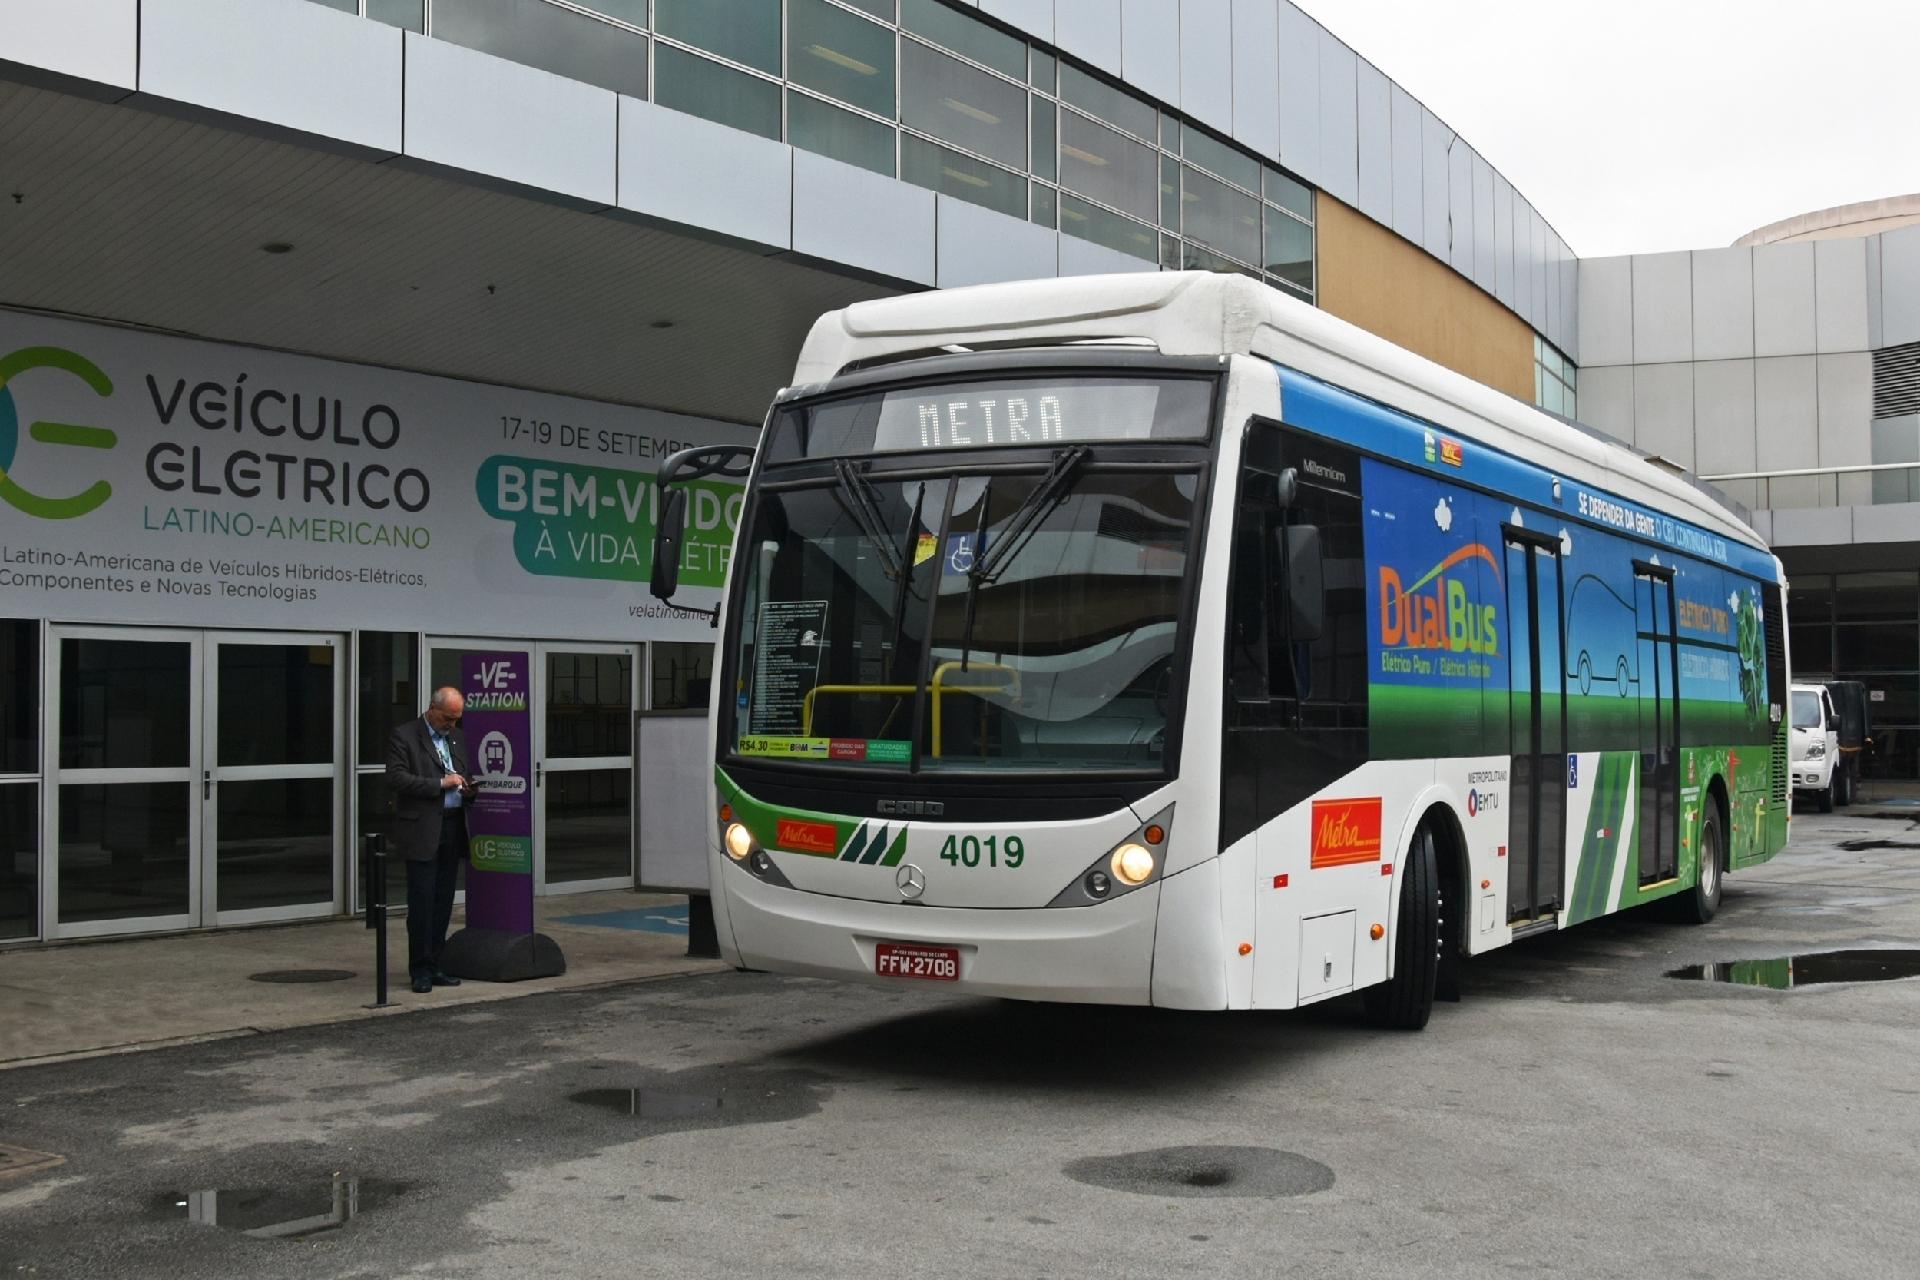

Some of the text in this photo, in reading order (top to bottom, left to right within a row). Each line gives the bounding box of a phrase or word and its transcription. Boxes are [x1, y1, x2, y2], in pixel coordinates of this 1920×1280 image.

[146, 373, 400, 450] VEÍCULO
[919, 396, 1063, 447] METRA
[500, 416, 700, 459] 17-19 DE SETEMB
[144, 505, 430, 549] LATINO-AMERICANO
[1577, 491, 1588, 515] SE
[1588, 496, 1624, 527] DEPENDER
[1624, 508, 1635, 531] DA
[1635, 512, 1655, 537] GENTE
[534, 520, 557, 560] À
[568, 530, 640, 566] VIDA
[0, 569, 317, 603] Componentes e Novas Tecnologias
[3, 546, 428, 588] Latino-Americana de Veículos Híbridos-Elétricos,
[1381, 651, 1412, 673] Elétrico
[465, 691, 525, 708] STATION
[1467, 770, 1508, 784] METROPOLITANO
[1478, 791, 1499, 811] EMTU
[940, 835, 1024, 868] 4019
